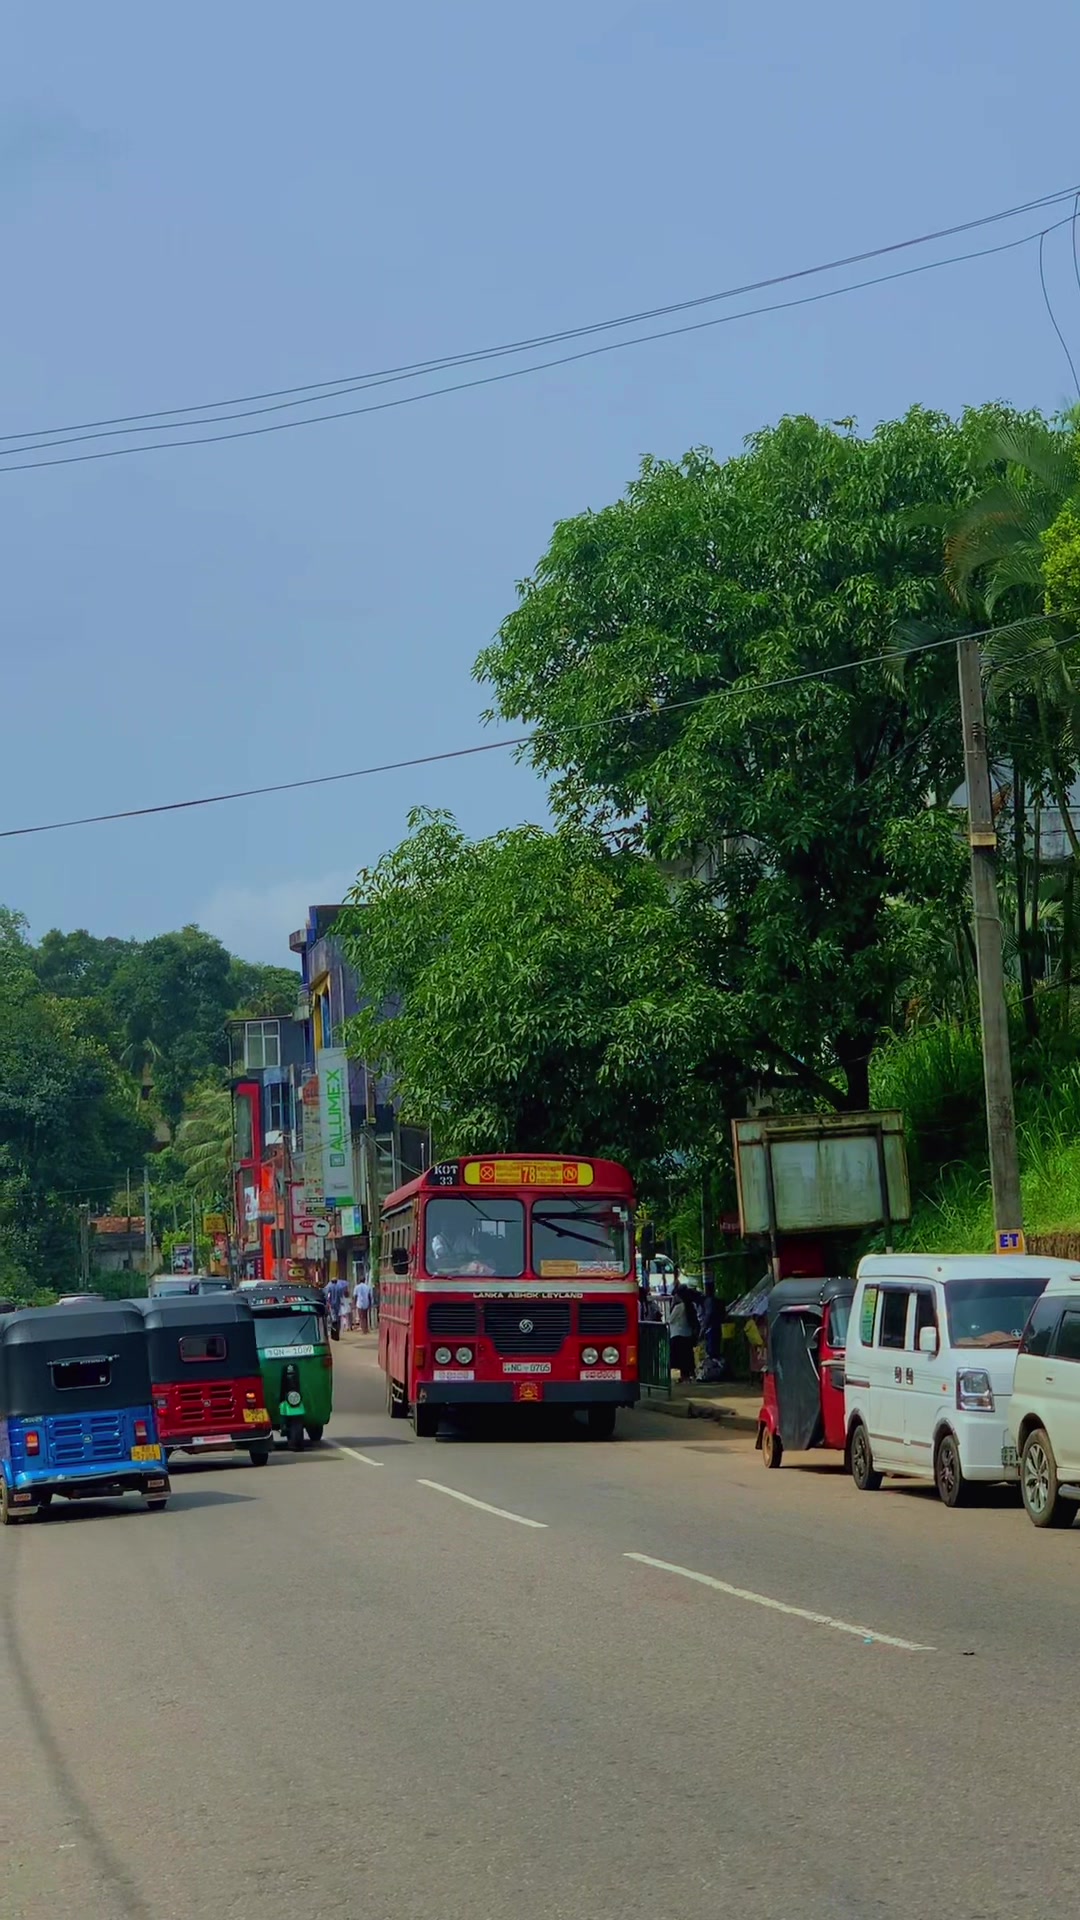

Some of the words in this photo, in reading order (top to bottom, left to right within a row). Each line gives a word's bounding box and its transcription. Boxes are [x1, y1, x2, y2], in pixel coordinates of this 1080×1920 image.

[326, 1068, 343, 1152] ALUMEX
[433, 1165, 459, 1175] KOT
[522, 1166, 536, 1183] 78
[439, 1177, 453, 1186] 33
[1000, 1233, 1019, 1248] ET
